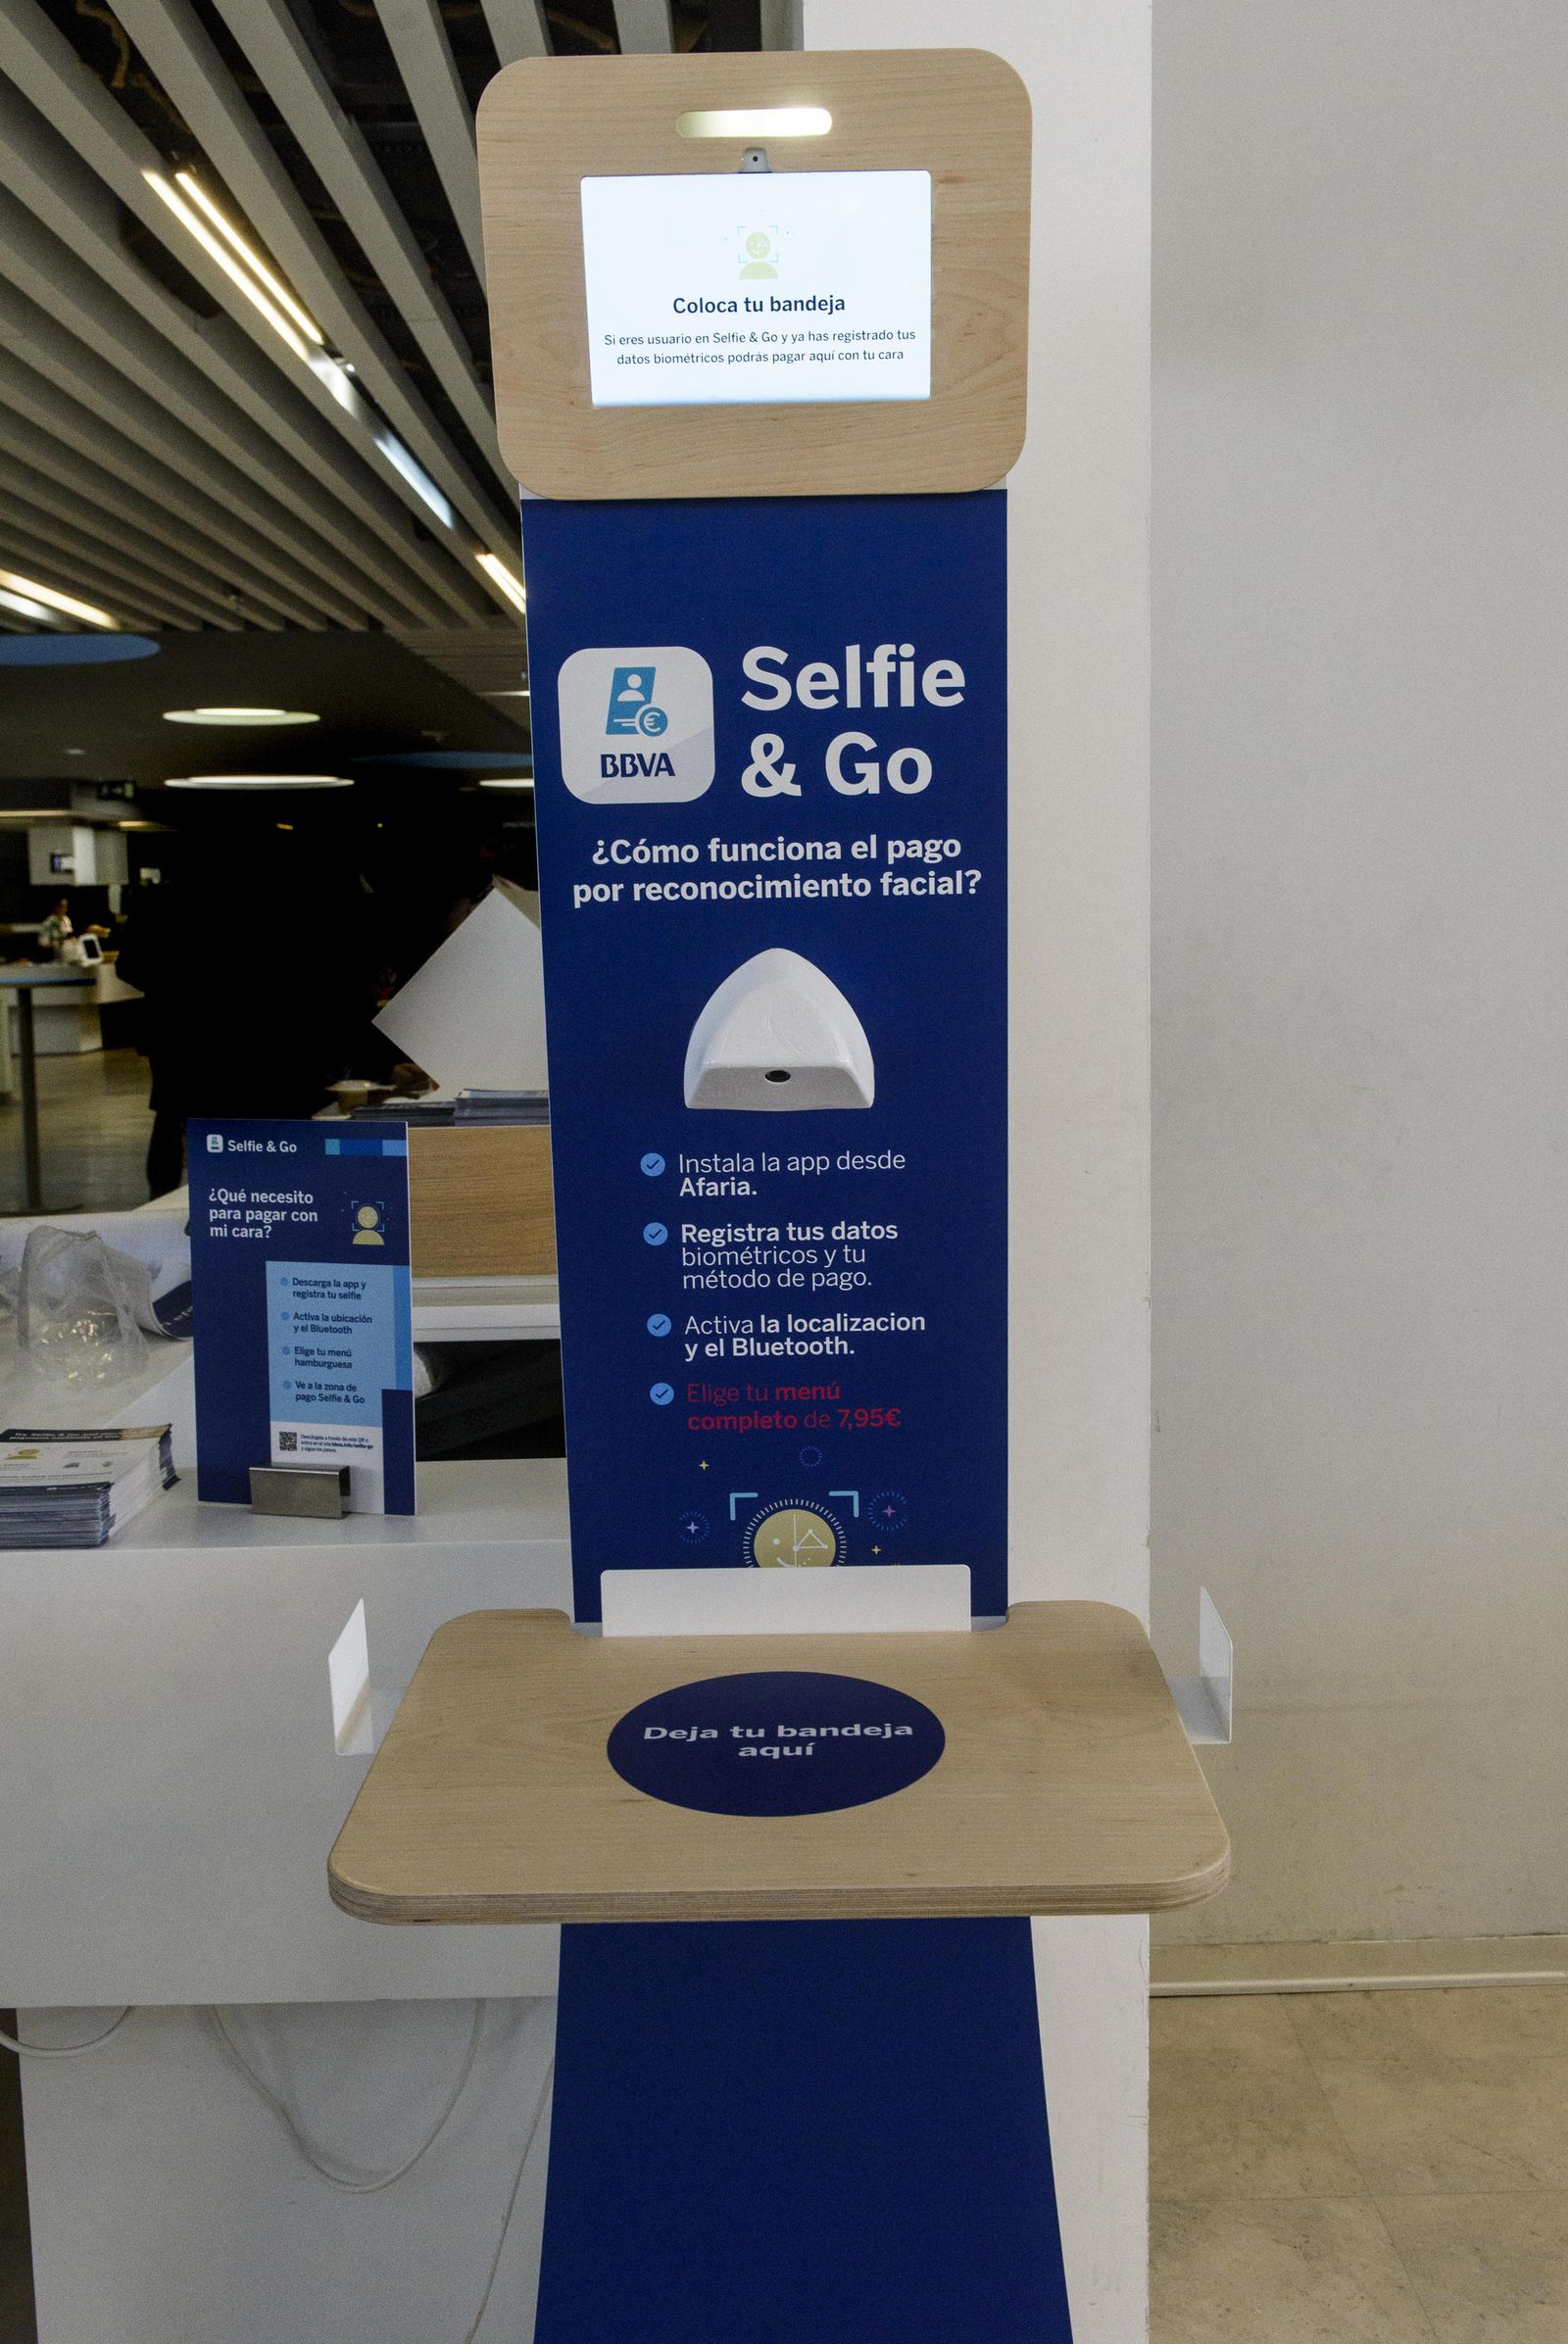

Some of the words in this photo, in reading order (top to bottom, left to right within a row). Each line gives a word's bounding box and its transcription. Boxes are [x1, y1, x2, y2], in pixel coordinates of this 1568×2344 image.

[673, 297, 738, 314] Coloca
[744, 297, 763, 313] tu
[769, 295, 845, 315] bandeja
[604, 334, 615, 346] Si
[619, 334, 644, 345] eres
[648, 333, 691, 345] usuario
[696, 334, 710, 344] en
[712, 331, 746, 344] Selfie
[749, 331, 759, 343] &
[761, 331, 778, 343] Go
[781, 333, 788, 345] y
[791, 332, 805, 344] ya
[808, 329, 829, 342] has
[832, 328, 894, 344] registrado
[897, 329, 915, 340] tus
[616, 352, 650, 365] datos
[655, 351, 724, 365] biométricos
[728, 350, 768, 365] podrás
[772, 351, 806, 365] pagar
[809, 351, 835, 364] aquí
[838, 351, 859, 361] con
[862, 349, 875, 361] tu
[878, 350, 904, 360] cara
[741, 643, 965, 711] Selfie
[601, 753, 675, 778] BBVA
[741, 733, 802, 798] &
[825, 731, 932, 795] Go
[592, 838, 699, 865] ¿Cómo
[709, 836, 841, 862] funciona
[852, 834, 877, 858] el
[887, 836, 961, 864] pago
[573, 882, 623, 908] por
[633, 872, 871, 902] reconocimiento
[880, 869, 982, 896] facial?
[227, 1140, 264, 1152] Selfie
[266, 1141, 276, 1152] &
[279, 1141, 297, 1152] Go
[679, 1153, 755, 1174] Instala
[761, 1152, 780, 1172] la
[787, 1154, 829, 1175] app
[837, 1149, 906, 1170] desde
[679, 1177, 758, 1196] Afaria.
[209, 1188, 246, 1204] ¿Qué
[251, 1190, 314, 1204] necesito
[209, 1208, 241, 1222] para
[245, 1210, 286, 1223] pagar
[291, 1211, 318, 1222] con
[210, 1225, 227, 1237] mi
[231, 1225, 272, 1239] cara?
[681, 1223, 779, 1247] Registra
[786, 1223, 824, 1242] tus
[831, 1221, 899, 1241] datos
[682, 1245, 817, 1267] biométricos
[824, 1248, 836, 1268] y
[843, 1245, 865, 1263] tu
[293, 1278, 331, 1289] Descarga
[333, 1279, 340, 1288] la
[361, 1281, 367, 1290] y
[683, 1268, 770, 1290] método
[777, 1268, 805, 1288] de
[811, 1270, 872, 1292] pago.
[338, 1292, 361, 1300] selfie
[293, 1312, 319, 1322] Activa
[321, 1313, 329, 1322] la
[331, 1314, 372, 1324] ubicación
[685, 1315, 754, 1335] Activa
[760, 1315, 780, 1334] la
[787, 1312, 926, 1333] localizacion
[293, 1325, 299, 1334] y
[301, 1324, 309, 1333] el
[311, 1325, 352, 1334] Bluetooth
[295, 1346, 315, 1357] Elige
[327, 1347, 352, 1357] menú
[685, 1342, 698, 1362] y
[705, 1339, 725, 1357] el
[733, 1336, 855, 1357] Bluetooth.
[295, 1359, 352, 1369] hamburguesa
[346, 1383, 357, 1392] de
[688, 1384, 739, 1405] Elige
[746, 1383, 768, 1402] tu
[775, 1381, 840, 1400] menú
[295, 1393, 316, 1403] pago
[318, 1393, 342, 1402] Selfie
[344, 1394, 351, 1403] &
[353, 1394, 365, 1403] Go
[688, 1410, 797, 1433] completo
[804, 1410, 831, 1428] de
[837, 1407, 901, 1430] 7,95€
[644, 1726, 718, 1742] Deja
[730, 1726, 764, 1738] tu
[777, 1724, 913, 1738] bandeja
[738, 1742, 816, 1759] aquí
